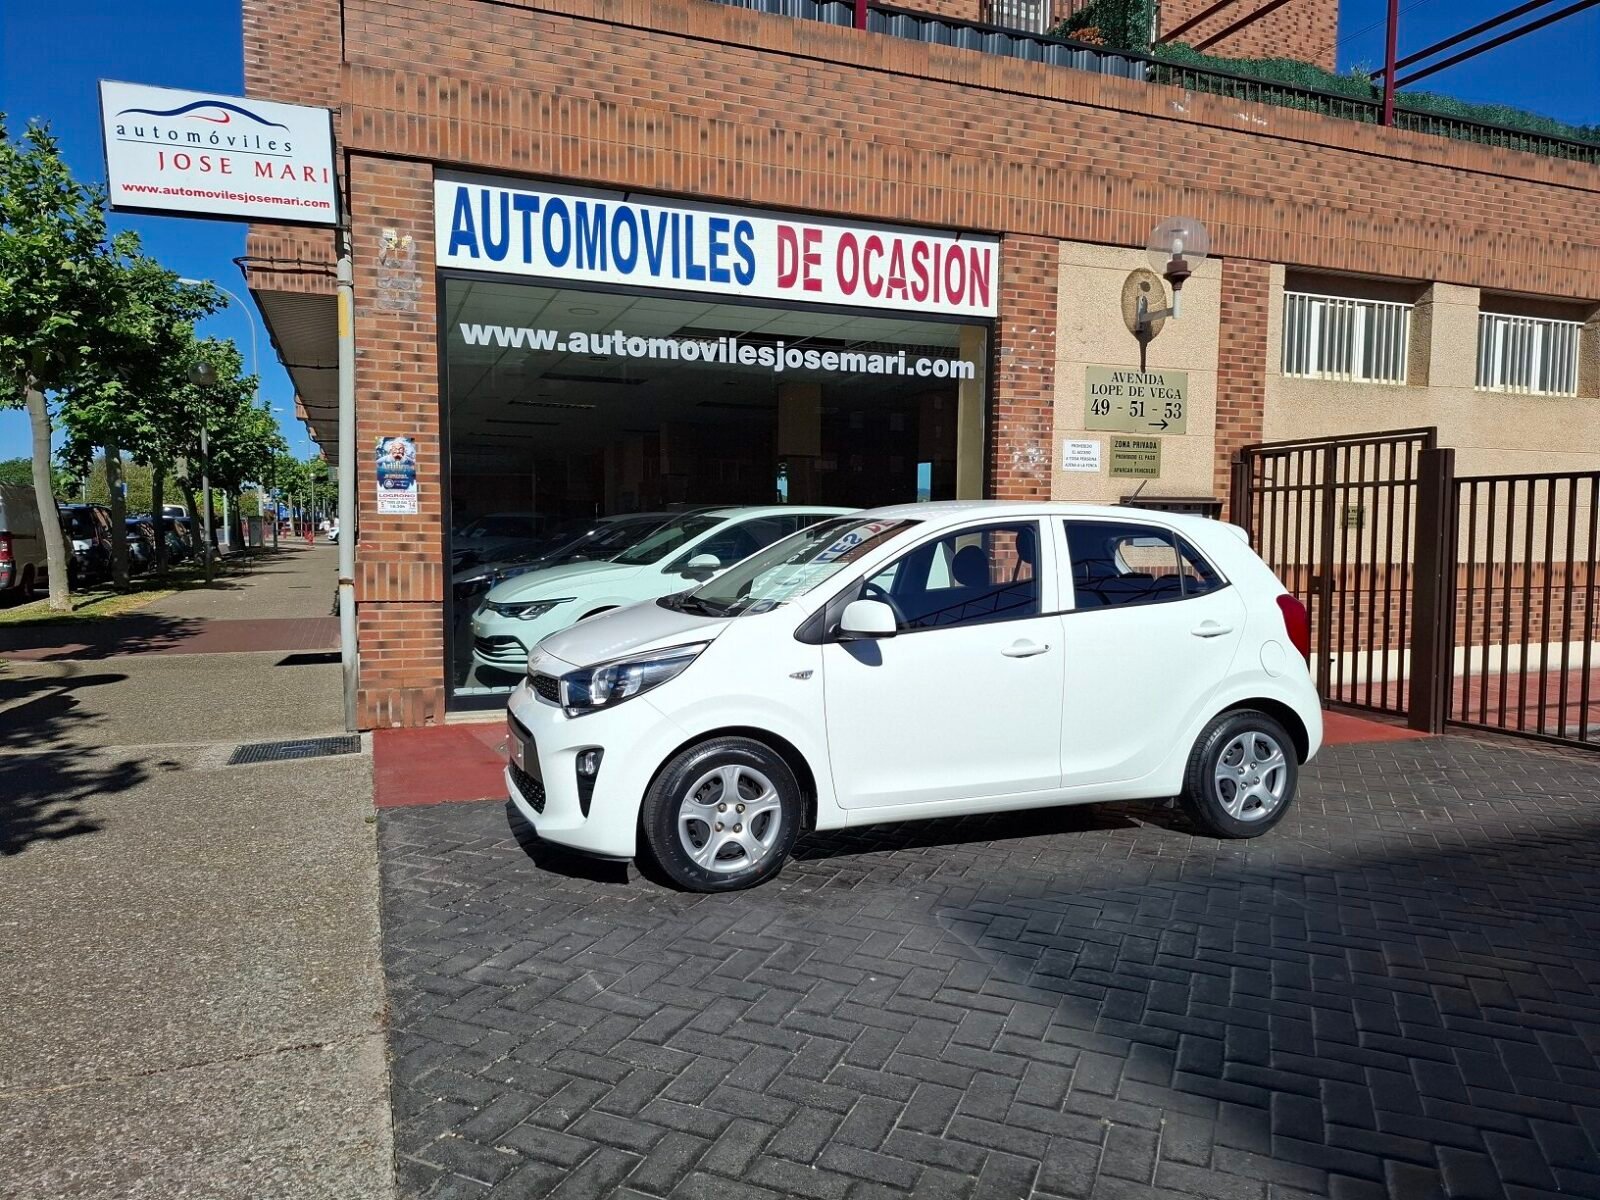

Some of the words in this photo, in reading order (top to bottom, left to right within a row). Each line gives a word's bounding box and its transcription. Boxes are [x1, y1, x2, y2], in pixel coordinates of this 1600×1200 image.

[116, 123, 292, 152] automóviles
[158, 152, 232, 174] JOSE
[255, 161, 329, 184] MARI
[122, 183, 330, 209] www.automovilesjosemari.com
[777, 224, 823, 292] DE
[460, 322, 975, 380] www.automovilesjosemari.com
[1111, 371, 1165, 386] AVENIDA
[1091, 384, 1123, 397] LOPE
[1128, 386, 1145, 398] DE
[1150, 388, 1182, 400] VEGA
[1091, 398, 1110, 416] 49
[1129, 401, 1145, 417] 51
[1164, 403, 1182, 419] 53
[1114, 440, 1130, 448] ZONA
[1132, 441, 1157, 449] PRIVADA
